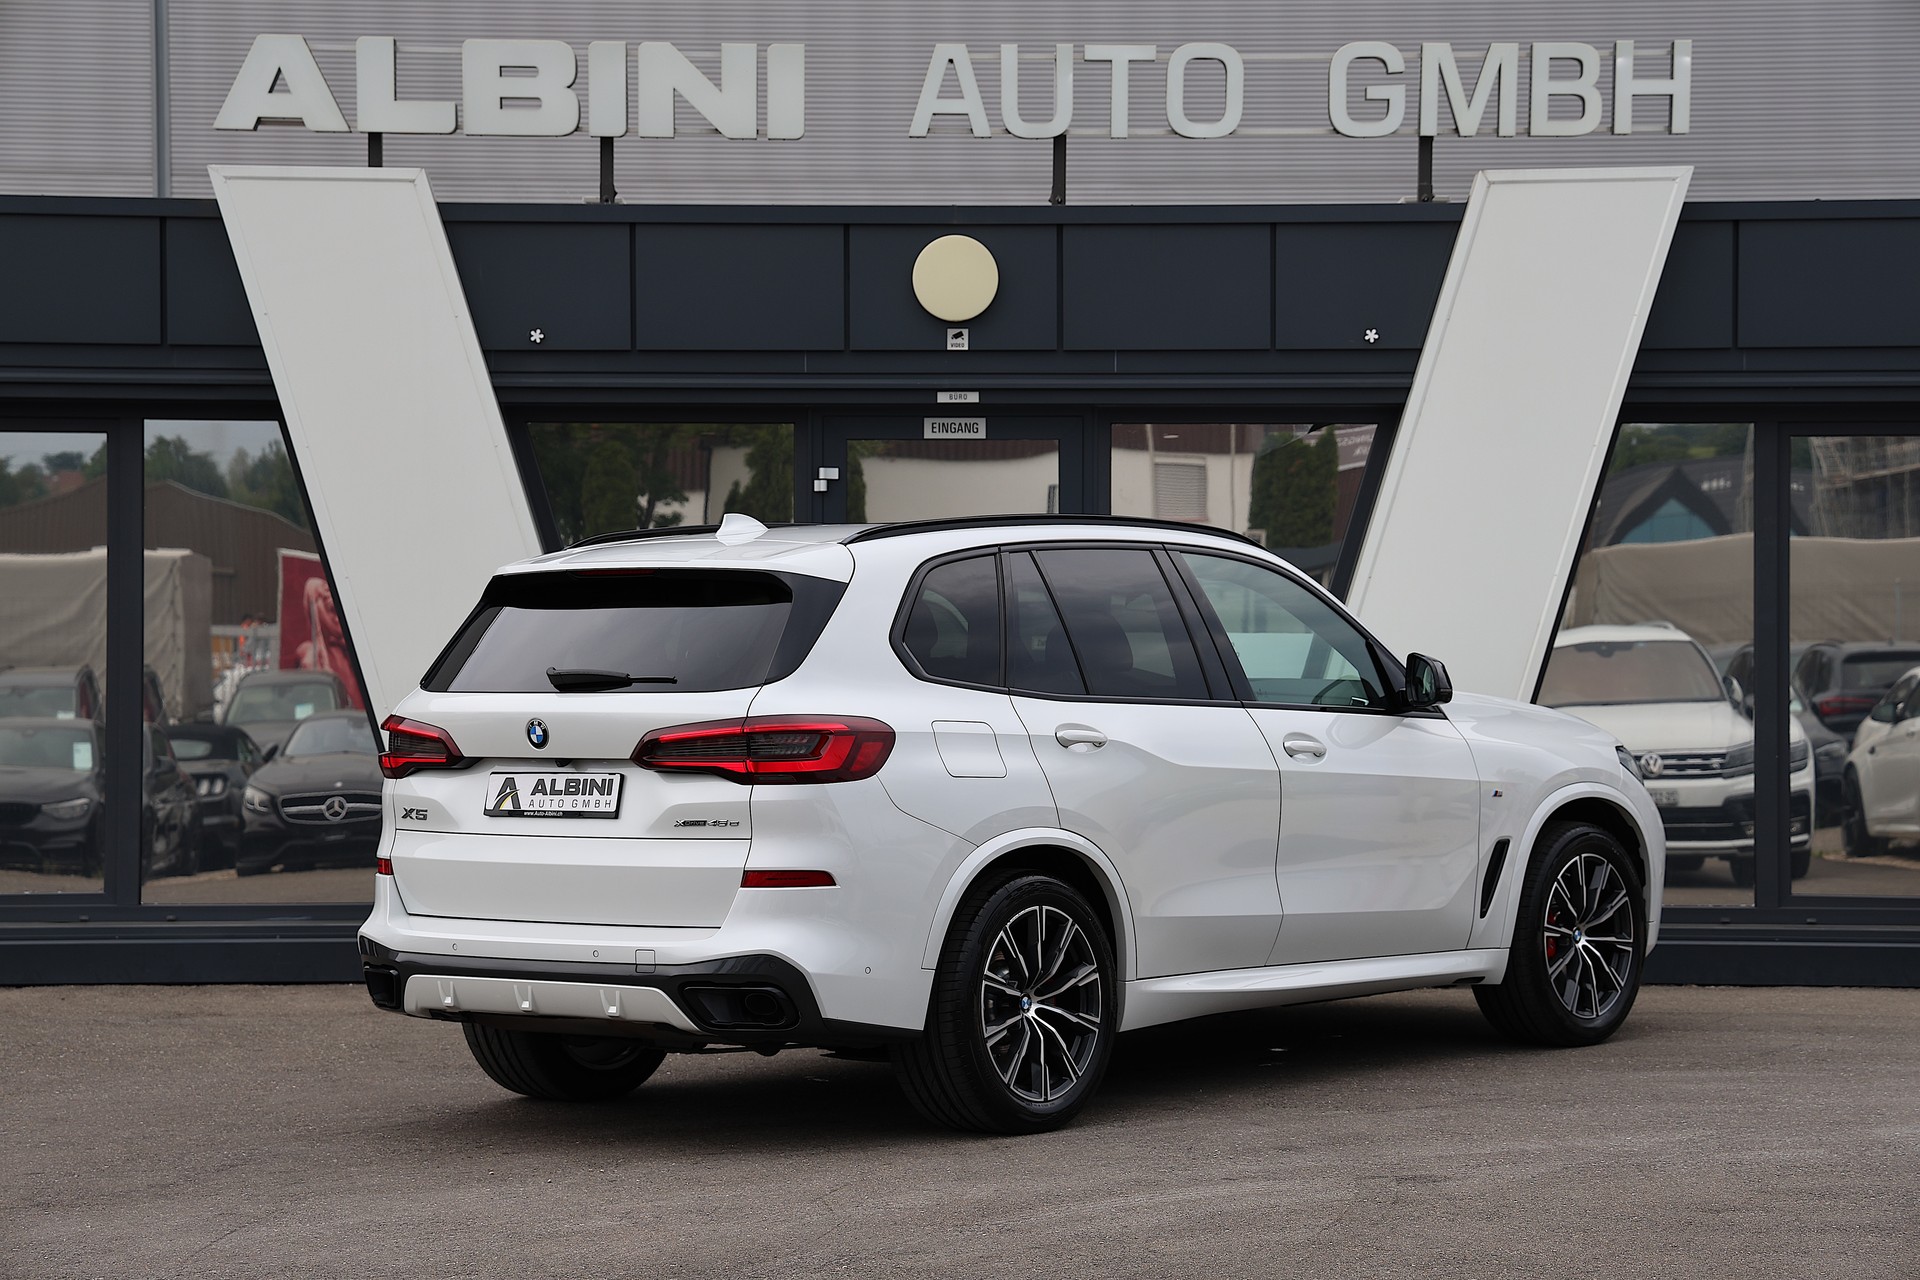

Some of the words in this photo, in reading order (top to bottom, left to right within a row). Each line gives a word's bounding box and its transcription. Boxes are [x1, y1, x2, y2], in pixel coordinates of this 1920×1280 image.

[212, 33, 805, 140] ALBINI
[908, 42, 1245, 139] AUTO
[1328, 40, 1692, 137] GMBH
[948, 393, 968, 401] BÜRO
[931, 422, 979, 434] EINGANG
[530, 778, 614, 796] ALBINI
[528, 798, 565, 809] AUTO
[571, 798, 612, 809] GMBH
[401, 807, 428, 821] X5
[523, 810, 564, 818] www.Auto-Albini.ch
